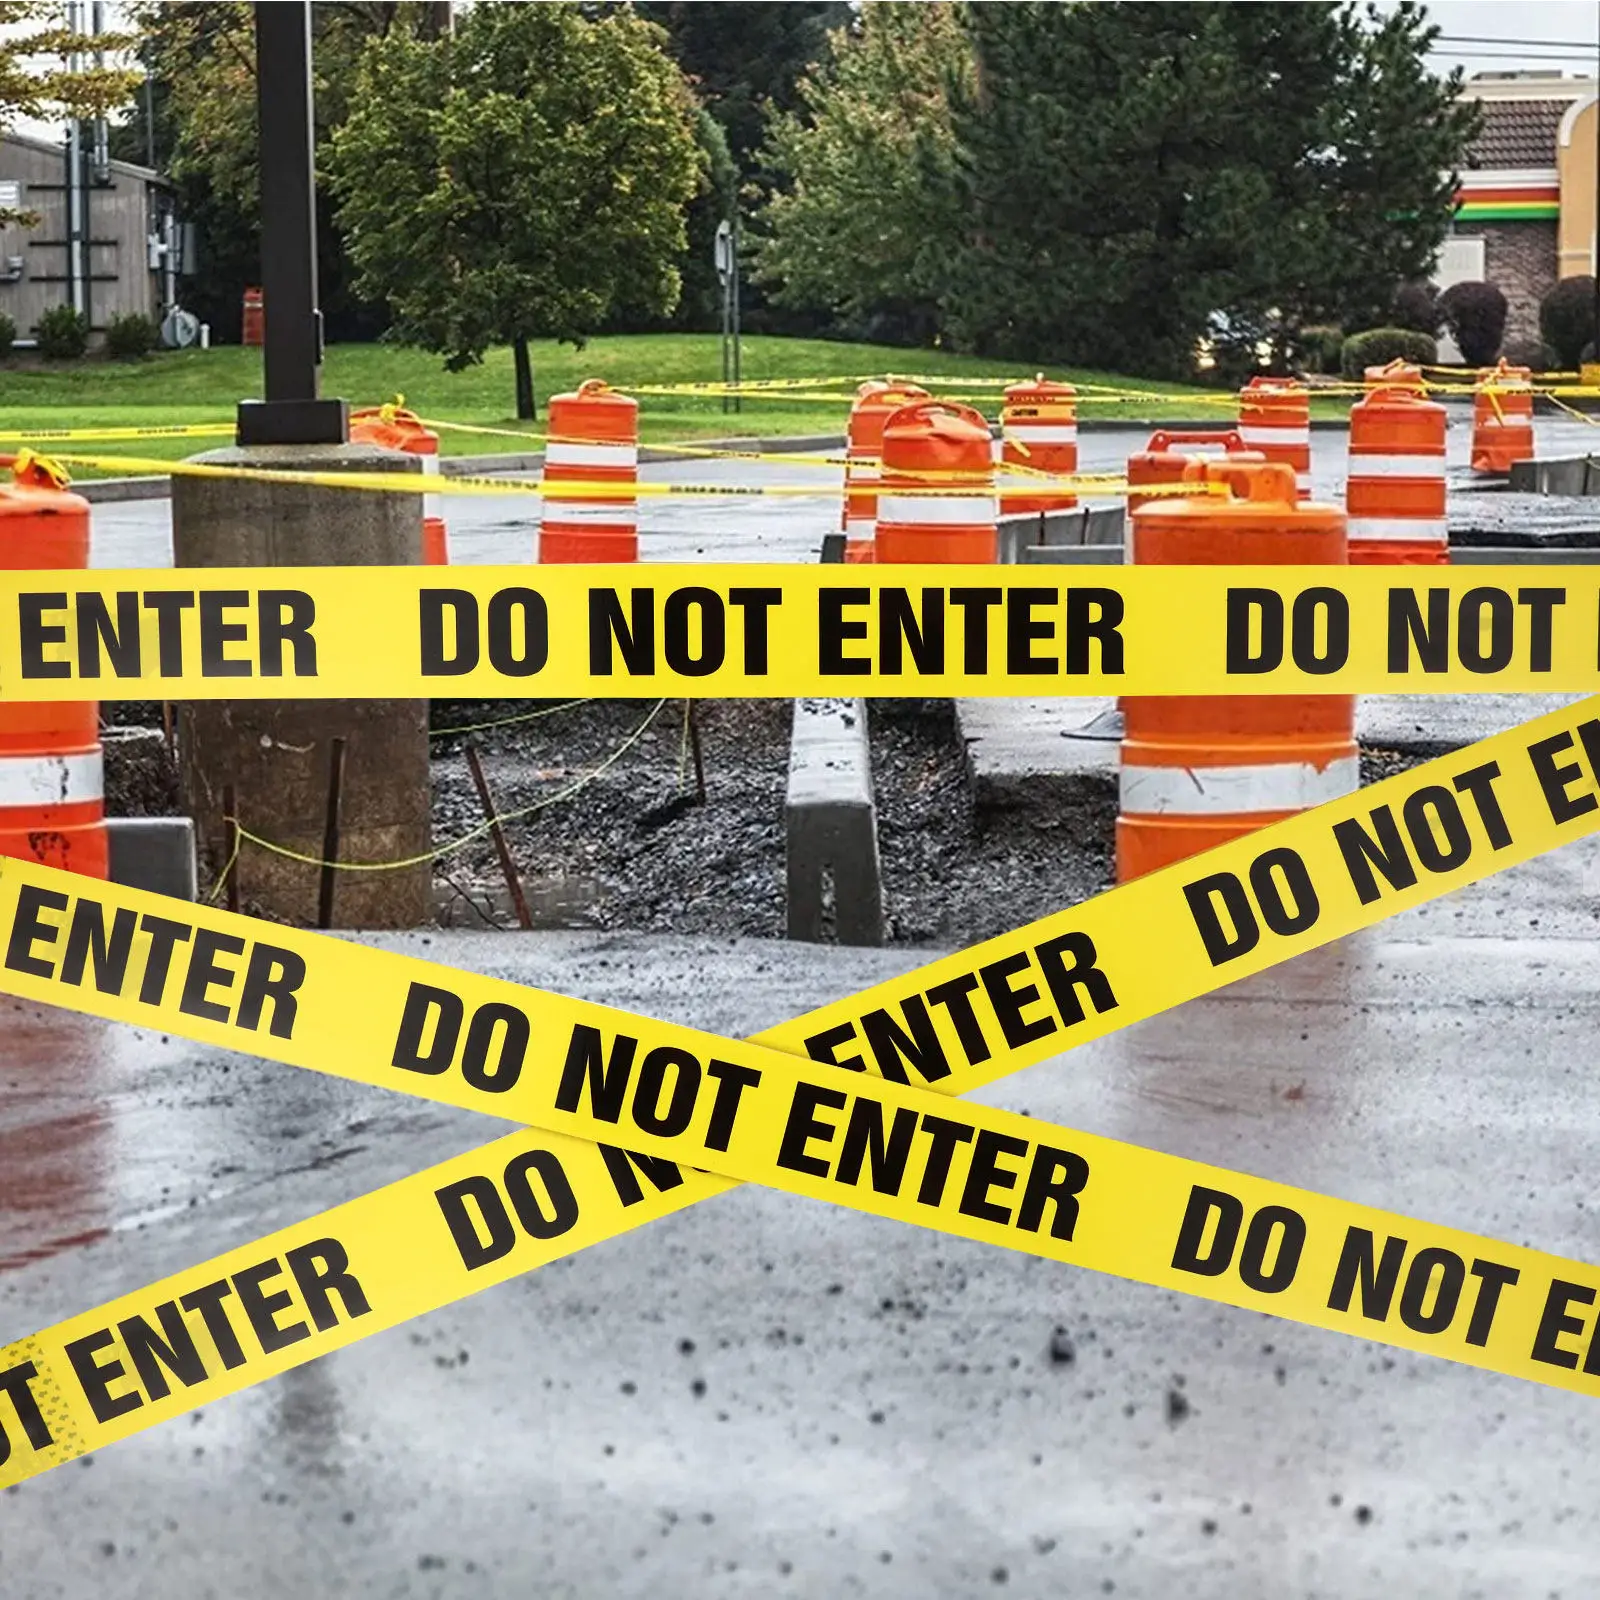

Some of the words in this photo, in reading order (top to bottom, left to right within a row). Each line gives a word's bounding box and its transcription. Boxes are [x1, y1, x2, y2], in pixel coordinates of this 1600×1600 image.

[19, 590, 317, 678] ENTER
[420, 587, 548, 676] DO
[589, 587, 782, 676] NOT
[819, 588, 1124, 675] ENTER
[1227, 587, 1349, 674] DO
[1388, 587, 1565, 673] NOT
[5, 885, 305, 1039] ENTER
[392, 982, 530, 1093] DO
[555, 1024, 762, 1152] NOT
[777, 1082, 1089, 1241] ENTER
[1171, 1185, 1306, 1293] DO
[1327, 1226, 1520, 1347] NOT
[64, 1238, 371, 1423] ENTER
[435, 1150, 578, 1271] DO
[1183, 848, 1319, 966] DO
[1332, 761, 1513, 905] NOT
